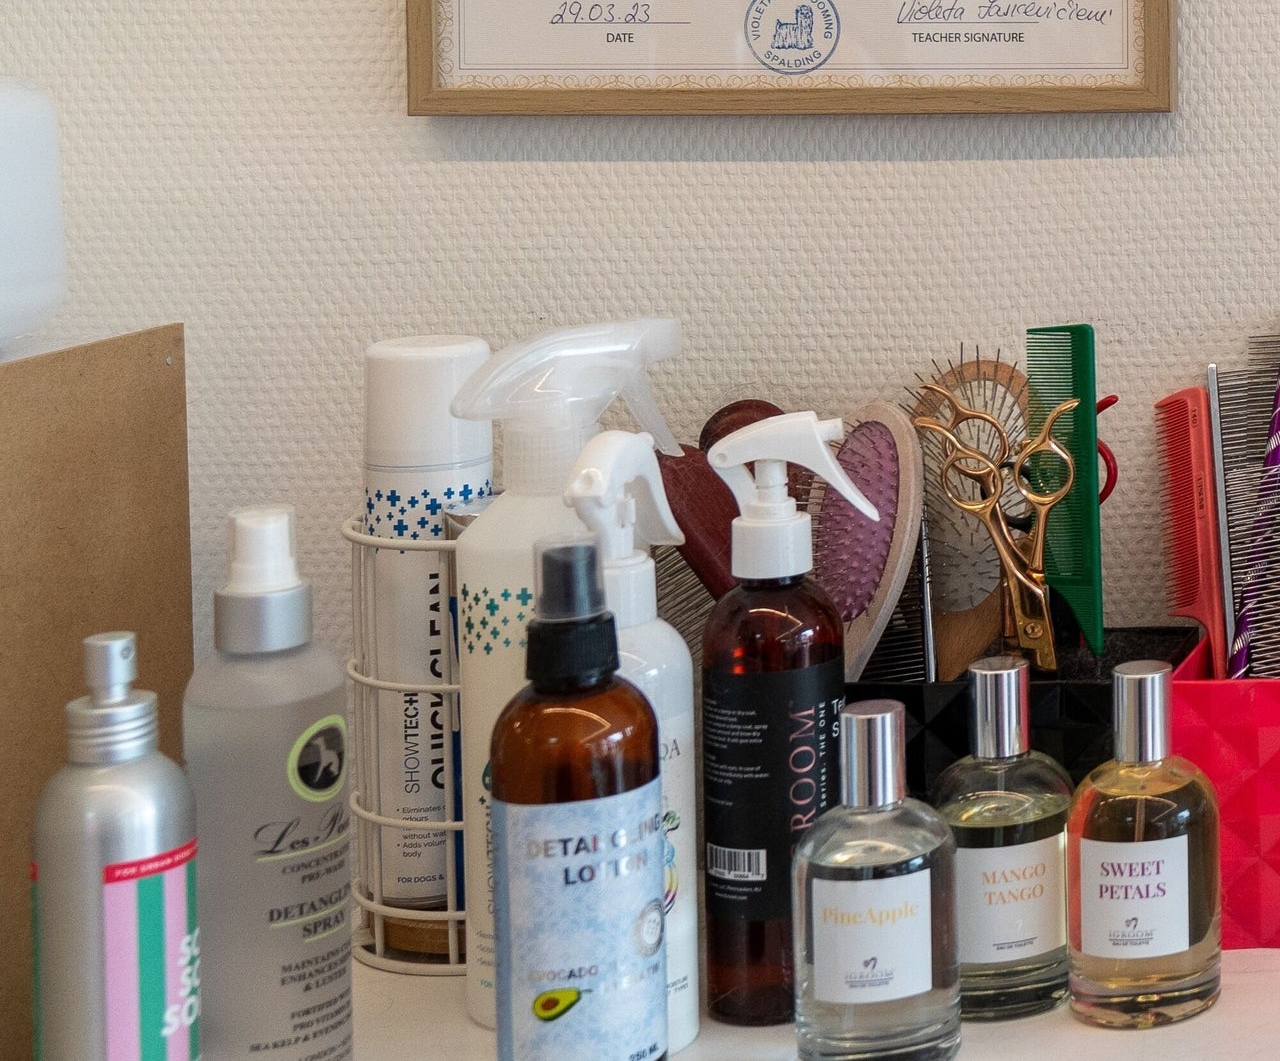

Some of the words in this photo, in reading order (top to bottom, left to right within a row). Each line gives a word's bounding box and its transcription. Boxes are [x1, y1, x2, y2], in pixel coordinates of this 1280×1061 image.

[606, 33, 634, 43] DATE
[912, 33, 961, 43] TEACHER
[964, 33, 1025, 43] SIGNATURE
[763, 49, 823, 68] SPALDING
[402, 805, 440, 814] Eliminates
[403, 850, 422, 858] body
[982, 863, 1046, 885] MANGO
[1100, 860, 1165, 877] SWEET
[414, 875, 437, 883] DOGS
[984, 884, 1045, 906] TANGO
[1100, 882, 1167, 900] PETALS
[822, 901, 919, 926] PineApple
[303, 910, 345, 937] SPRAY
